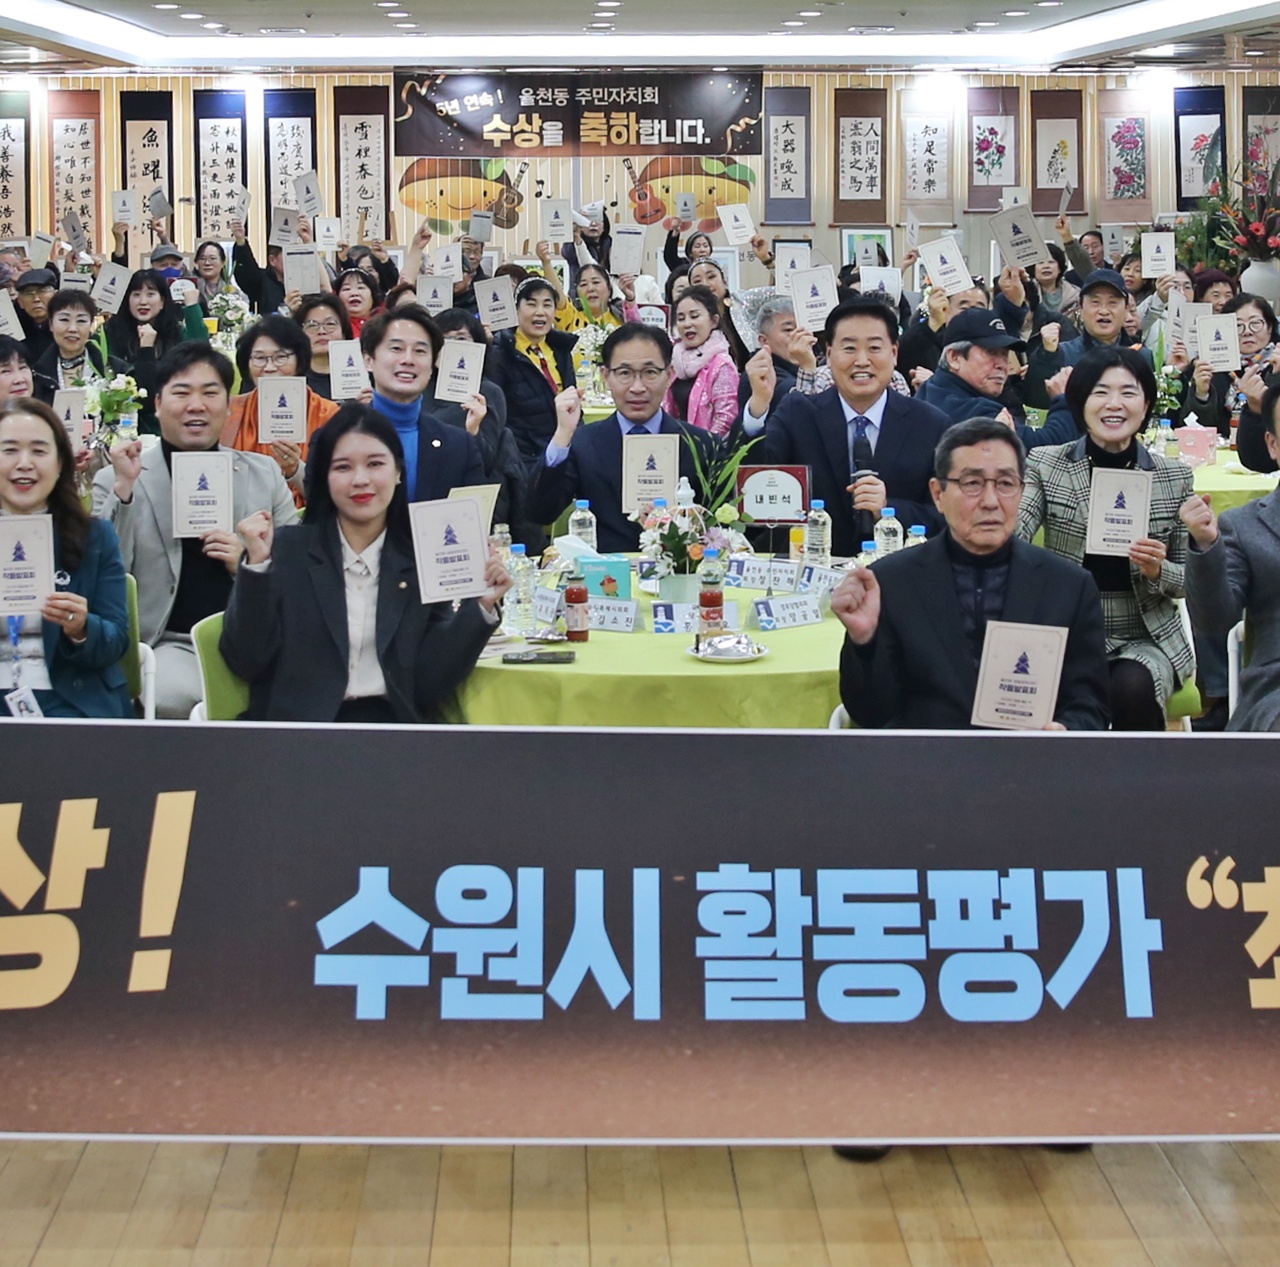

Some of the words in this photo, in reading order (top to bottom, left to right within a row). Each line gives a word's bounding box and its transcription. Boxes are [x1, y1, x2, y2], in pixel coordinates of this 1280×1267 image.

[435, 98, 461, 117] 5년
[463, 93, 496, 111] 연속
[518, 87, 570, 106] 율천동
[575, 87, 660, 105] 주민자치회
[483, 112, 564, 147] 수상을
[579, 111, 711, 147] 축하합니다.
[863, 122, 880, 193] 人間萬事
[921, 125, 938, 193] 知足常樂
[755, 494, 791, 504] 내빈석
[313, 864, 661, 1021] 수원시
[694, 863, 1163, 1023] 활동평가
